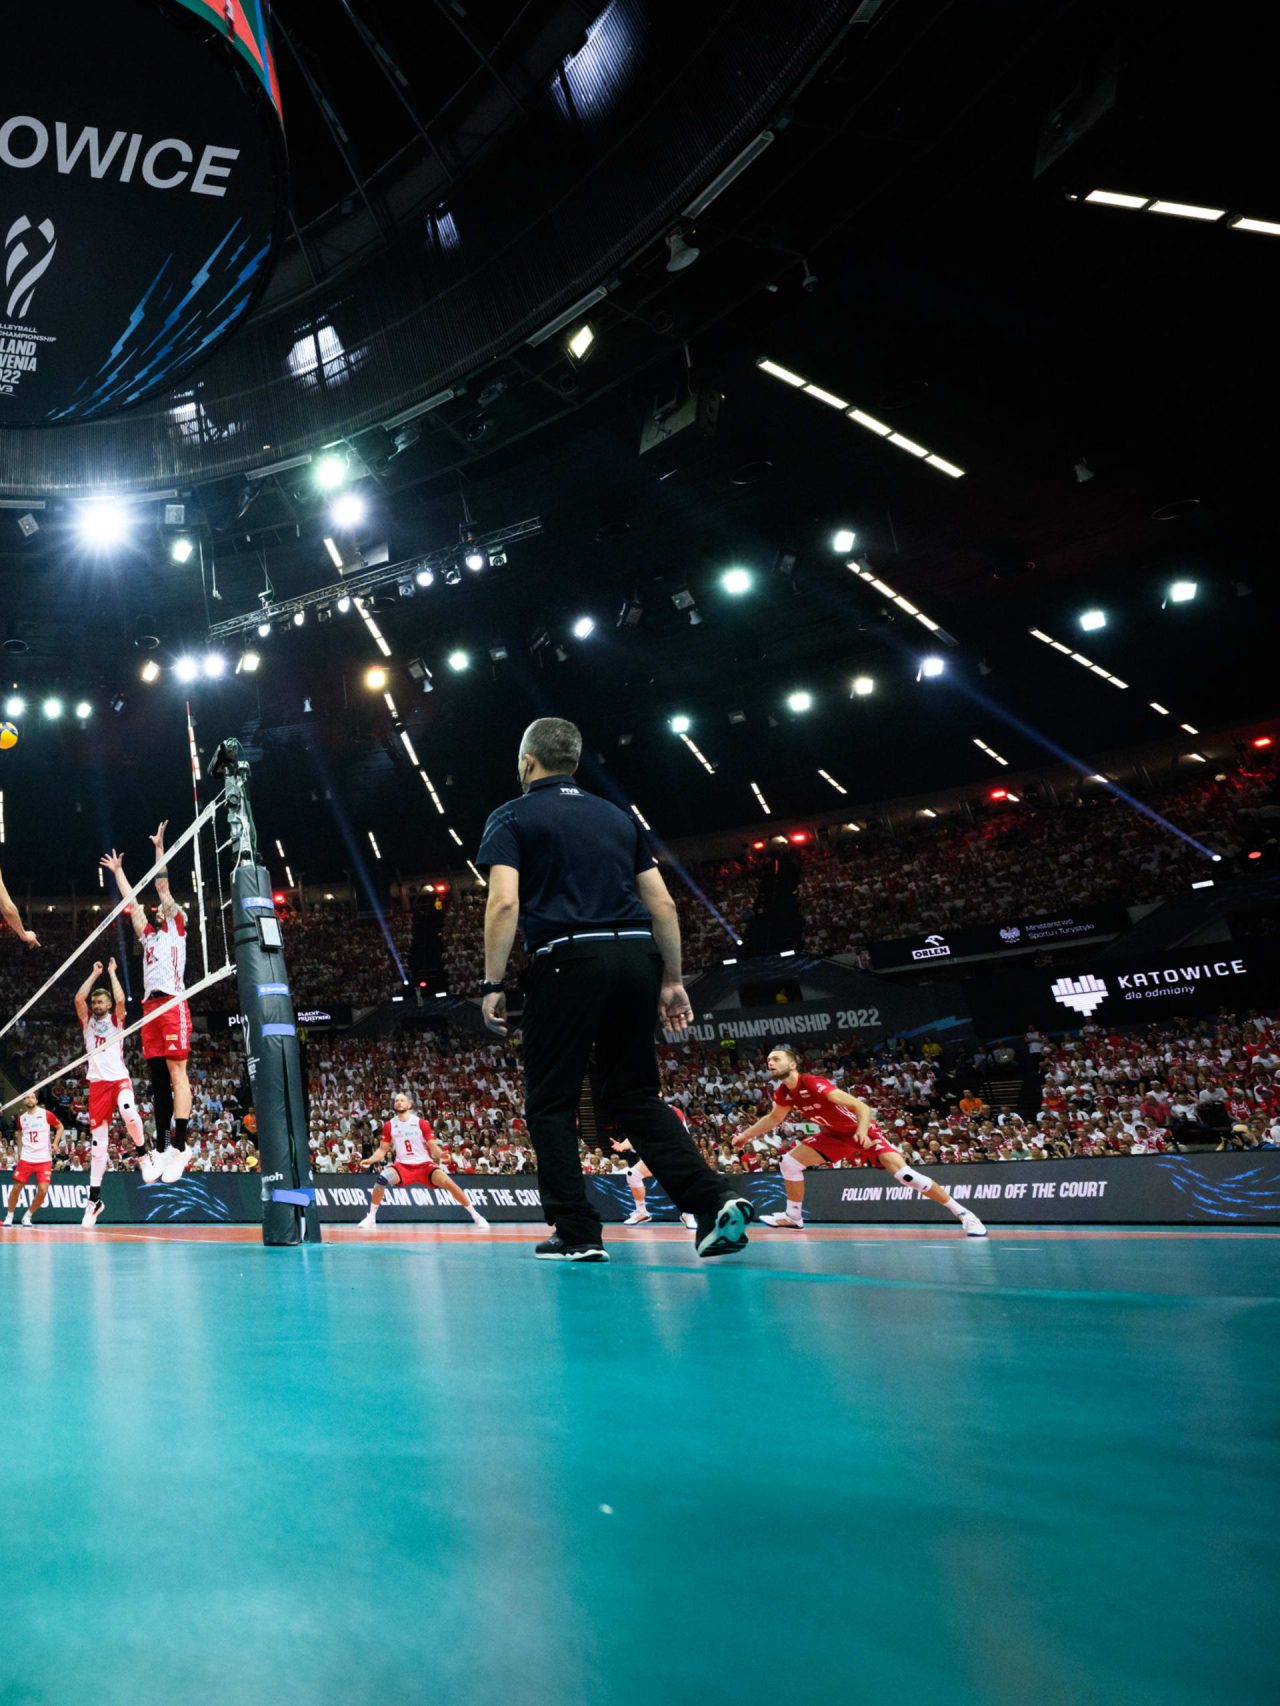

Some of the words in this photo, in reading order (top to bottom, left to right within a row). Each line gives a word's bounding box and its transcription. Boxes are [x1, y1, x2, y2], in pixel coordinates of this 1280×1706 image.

[914, 947, 949, 959] ORLEN
[1117, 959, 1247, 989] KATOWICE
[1125, 991, 1142, 1001] dla
[1145, 985, 1195, 999] odmiany
[719, 1012, 831, 1040] CHAMPIONSHIP
[835, 1008, 882, 1029] 2022
[28, 1131, 39, 1143] 12
[805, 1124, 815, 1134] L
[330, 1188, 368, 1206] YOUR
[412, 1188, 434, 1207] ON
[435, 1188, 460, 1207] AN
[468, 1189, 488, 1207] OFF
[488, 1189, 517, 1207] THE
[841, 1187, 882, 1201] FOLLOW
[885, 1186, 913, 1200] YOUR
[953, 1184, 971, 1200] ON
[974, 1183, 999, 1200] AND
[1004, 1183, 1029, 1199] OFF
[1031, 1182, 1056, 1199] THE
[1059, 1180, 1108, 1198] COURT
